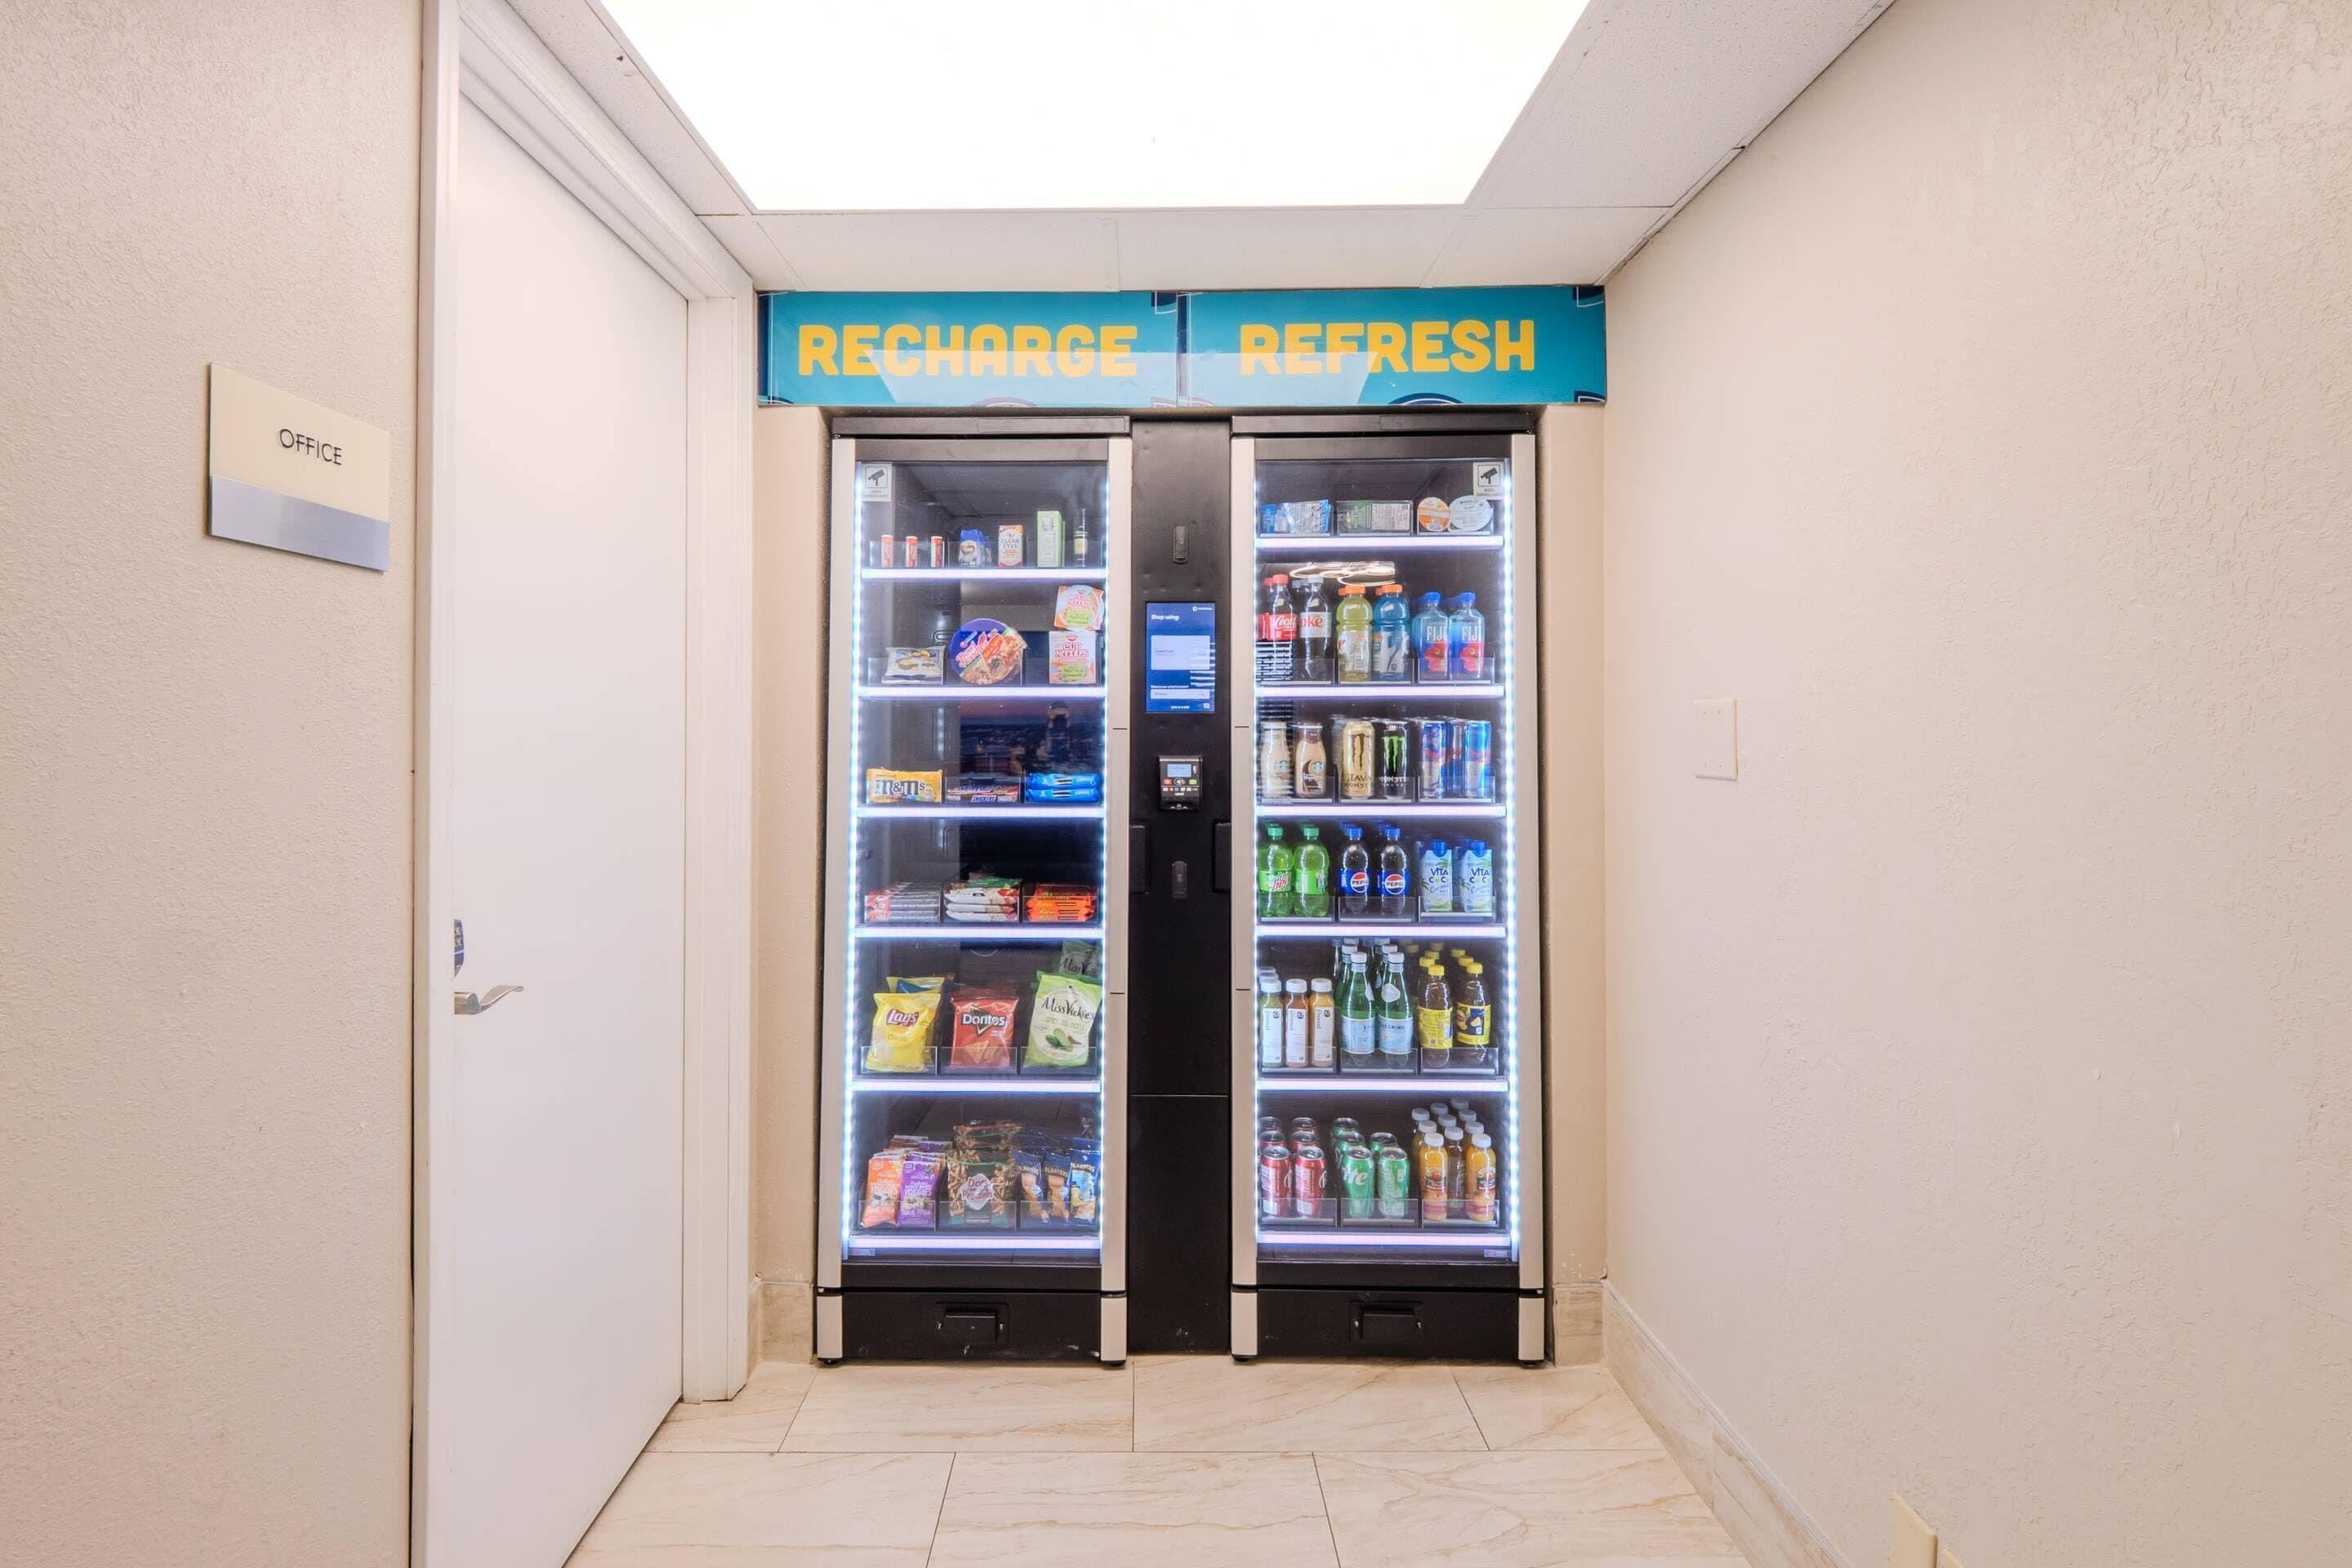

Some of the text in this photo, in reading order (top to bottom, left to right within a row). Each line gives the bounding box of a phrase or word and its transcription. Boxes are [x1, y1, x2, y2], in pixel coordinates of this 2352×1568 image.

[798, 323, 1138, 378] RECHARGE
[1238, 318, 1536, 376] REFRESH
[278, 428, 342, 466] OFFICE
[1299, 614, 1324, 628] oke
[1430, 868, 1449, 876] VITA
[1471, 868, 1490, 876] VITA
[1041, 996, 1066, 1013] Miss
[962, 1013, 1006, 1026] Doritos
